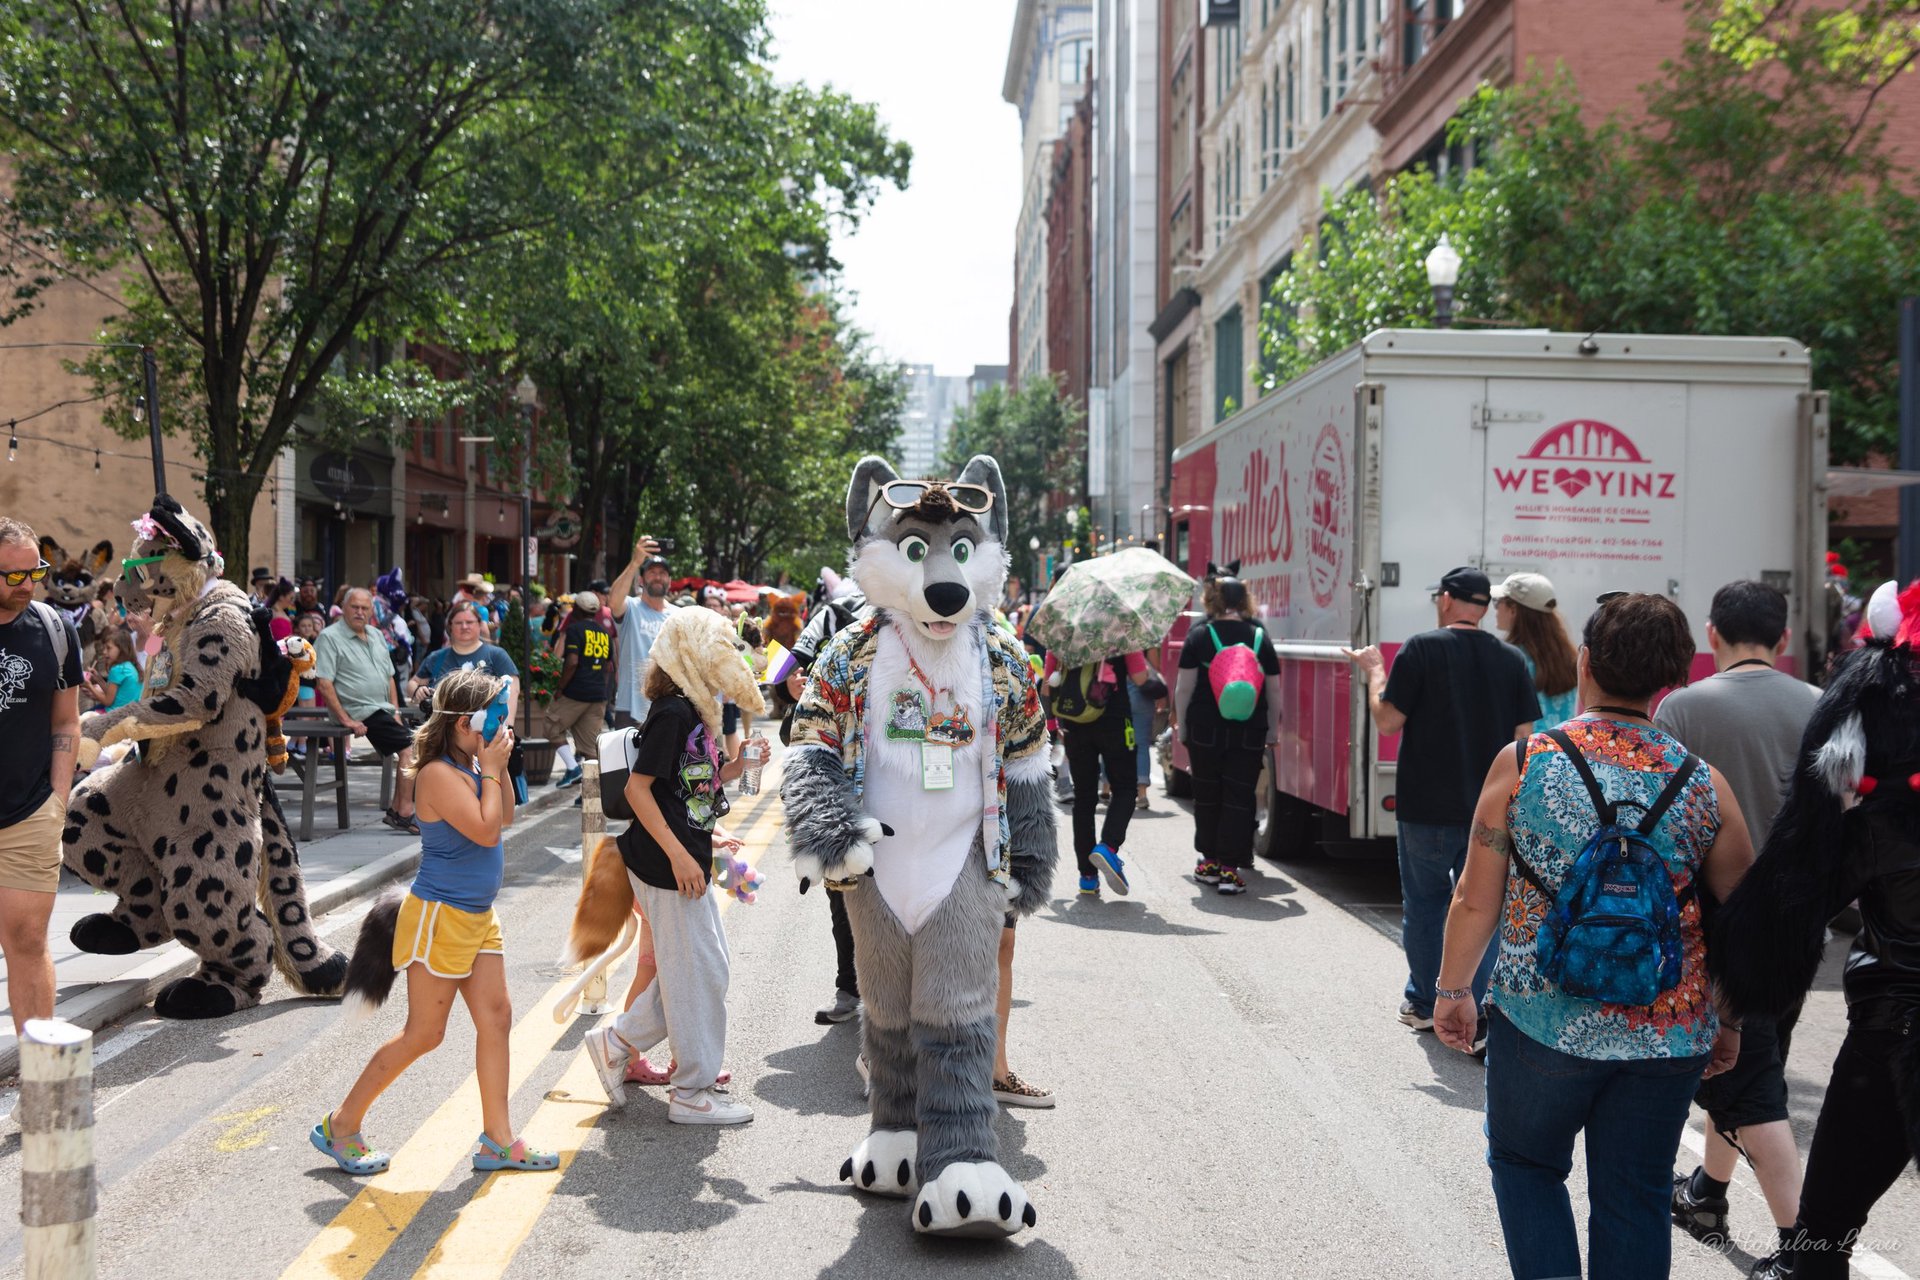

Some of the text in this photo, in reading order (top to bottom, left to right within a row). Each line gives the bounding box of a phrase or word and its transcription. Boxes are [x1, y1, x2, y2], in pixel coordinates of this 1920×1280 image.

[1493, 467, 1676, 499] WE YINZ
[1220, 440, 1293, 568] millie's
[1514, 504, 1650, 516] MILLIE'S HOMEMADE ICE CREAM
[1604, 516, 1616, 525] PA
[1311, 528, 1337, 567] Works
[1501, 534, 1593, 545] @MilliesTruckPGH
[1501, 549, 1662, 561] TruckPGH@MilliesHomemade.com
[584, 629, 609, 646] RUN
[584, 642, 610, 659] BOS
